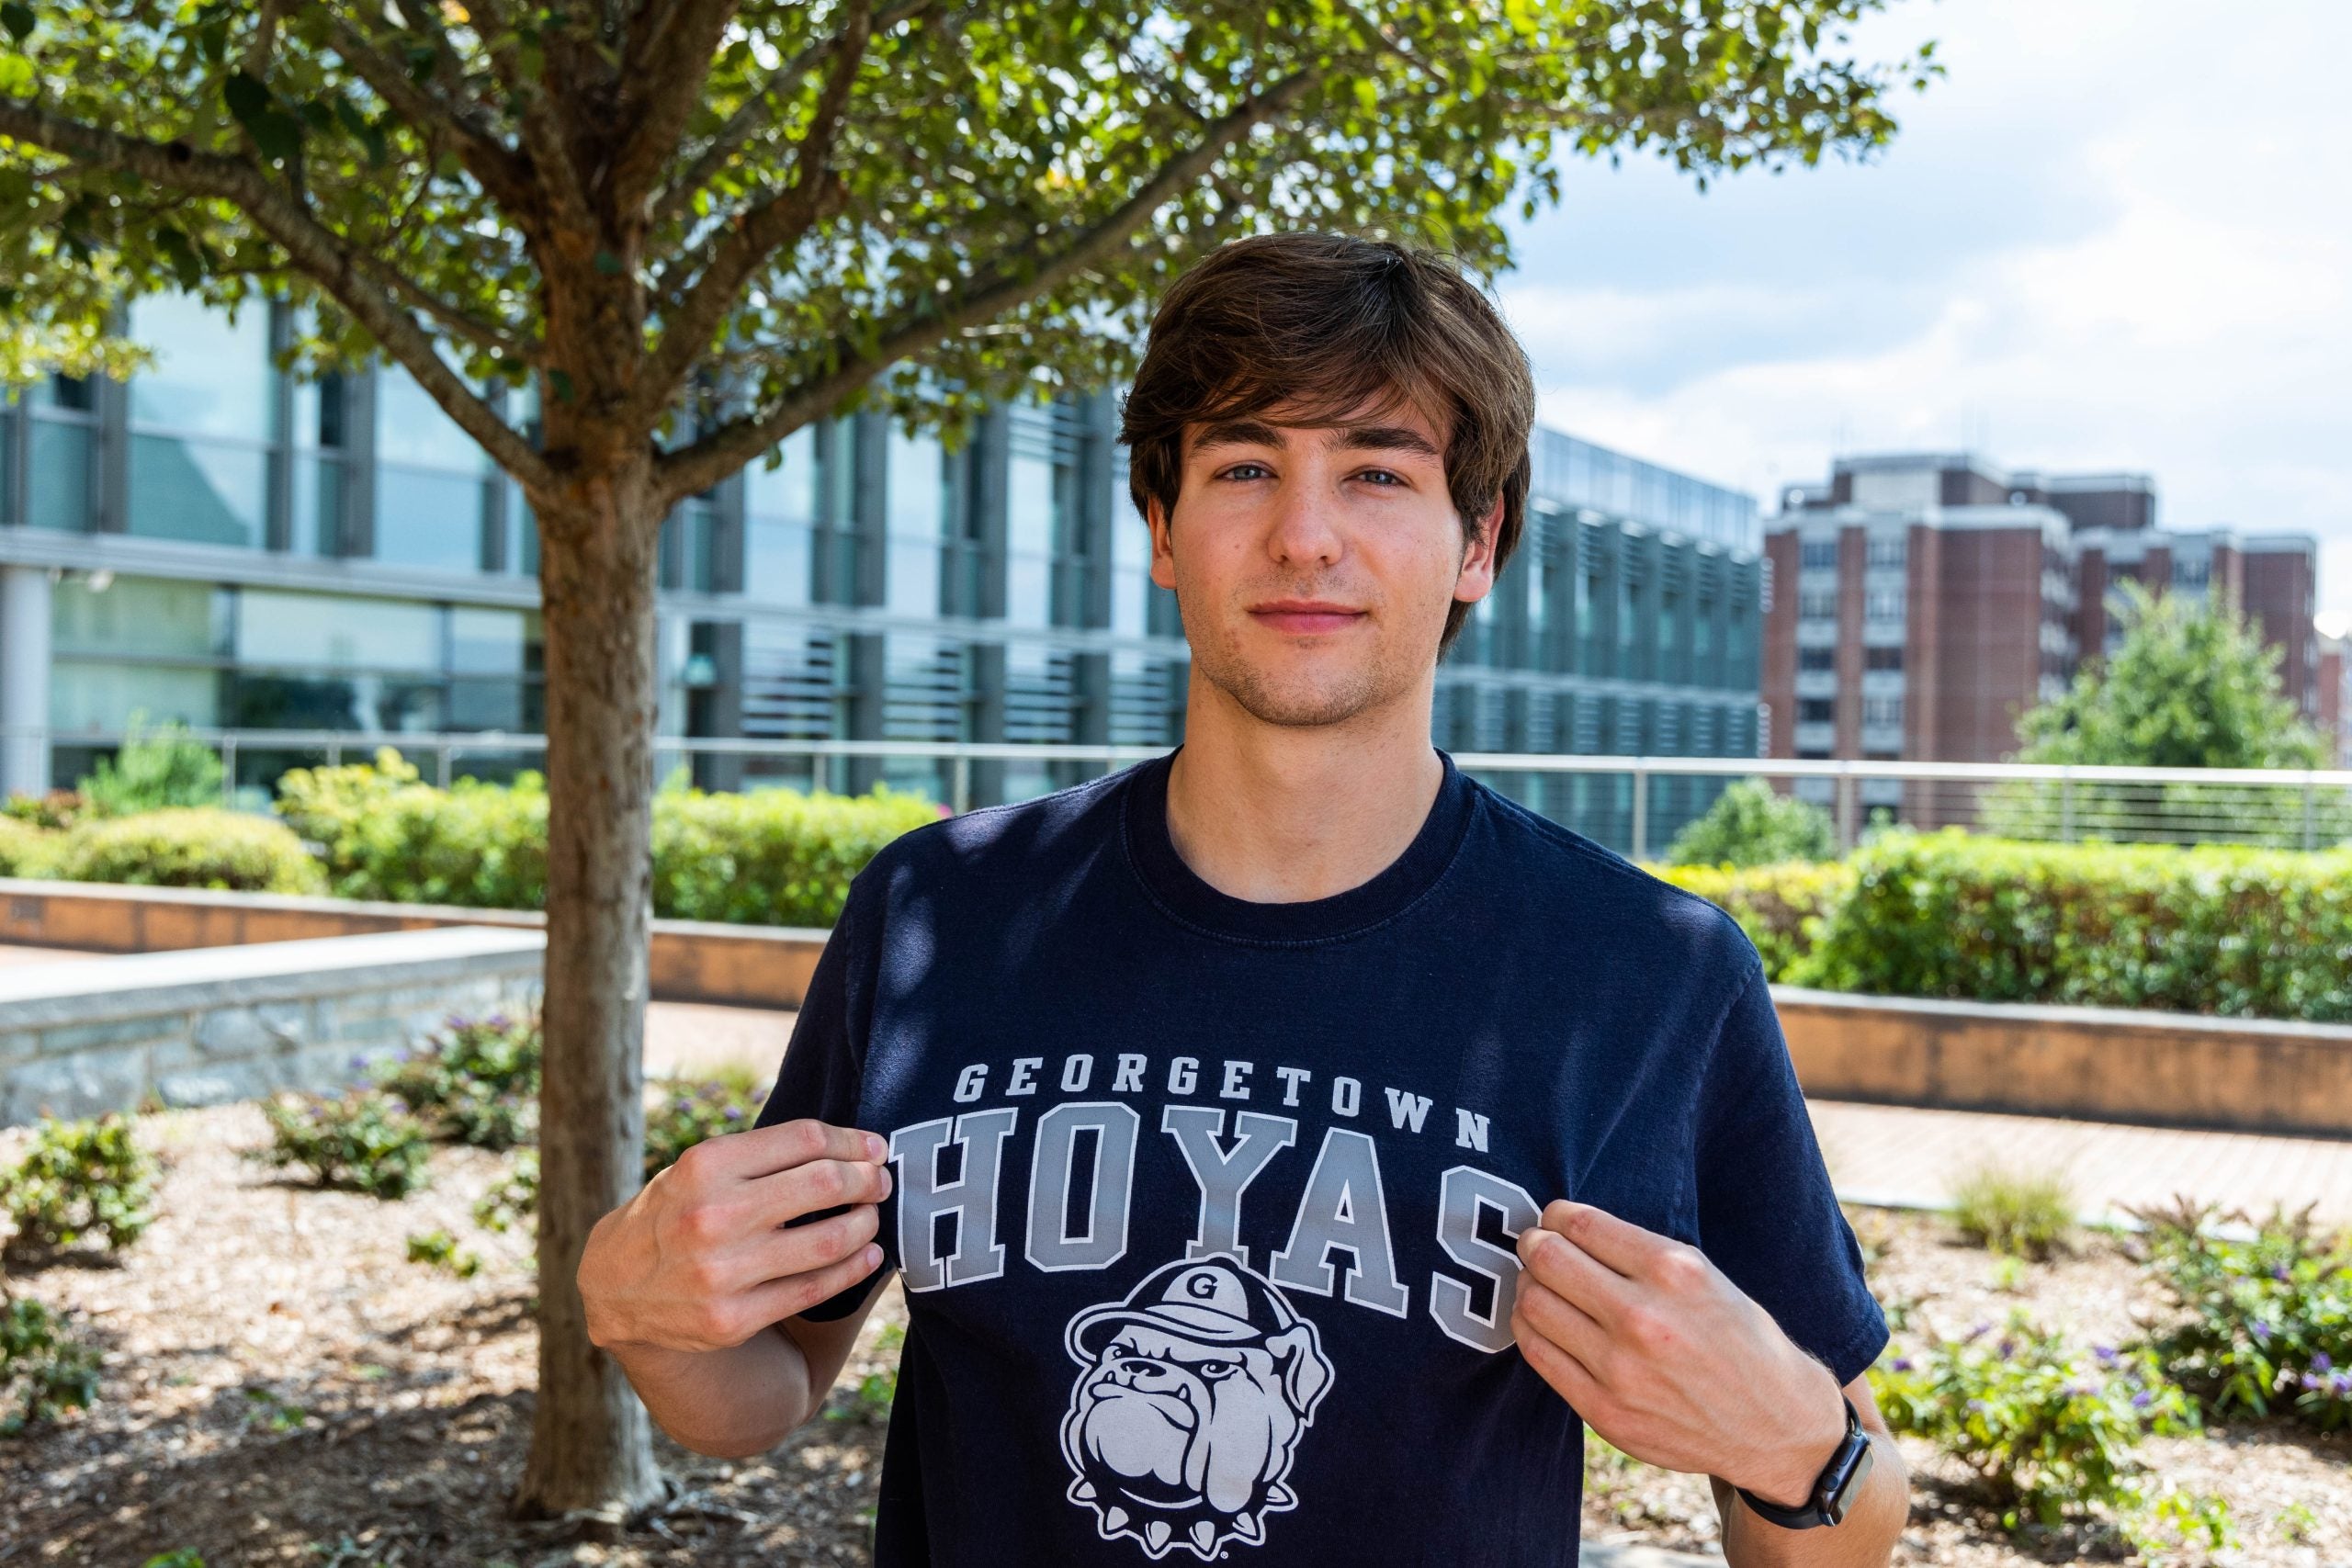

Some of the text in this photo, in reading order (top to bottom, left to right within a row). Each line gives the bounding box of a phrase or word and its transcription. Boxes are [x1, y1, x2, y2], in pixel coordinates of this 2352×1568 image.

[954, 1053, 1490, 1153] GEORGETOWN
[889, 1102, 1543, 1353] HOYAS
[1186, 1273, 1217, 1300] G
